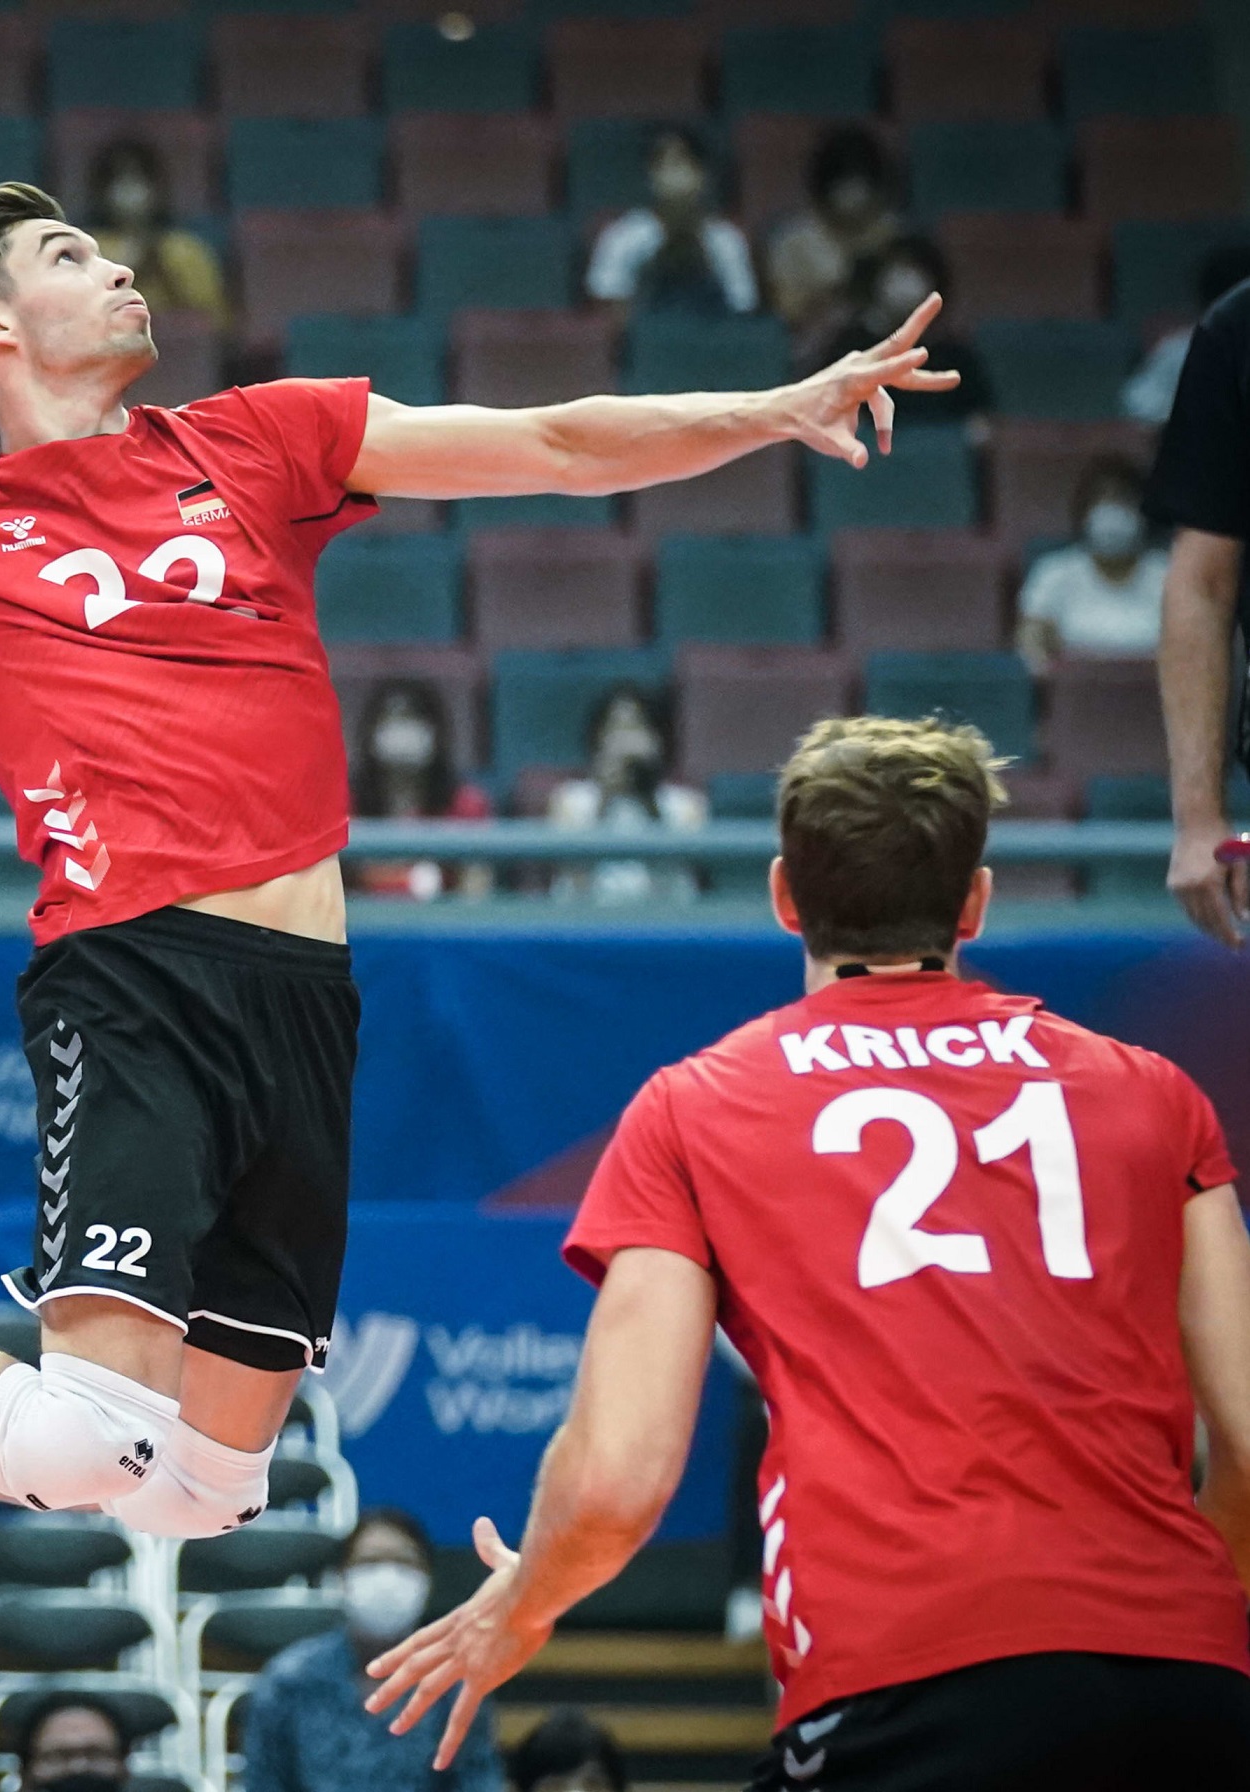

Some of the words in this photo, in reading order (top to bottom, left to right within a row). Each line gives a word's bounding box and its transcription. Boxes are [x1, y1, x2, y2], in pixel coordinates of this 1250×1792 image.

[779, 1015, 1050, 1074] KRICK
[812, 1081, 1094, 1289] 21
[81, 1223, 152, 1278] 22
